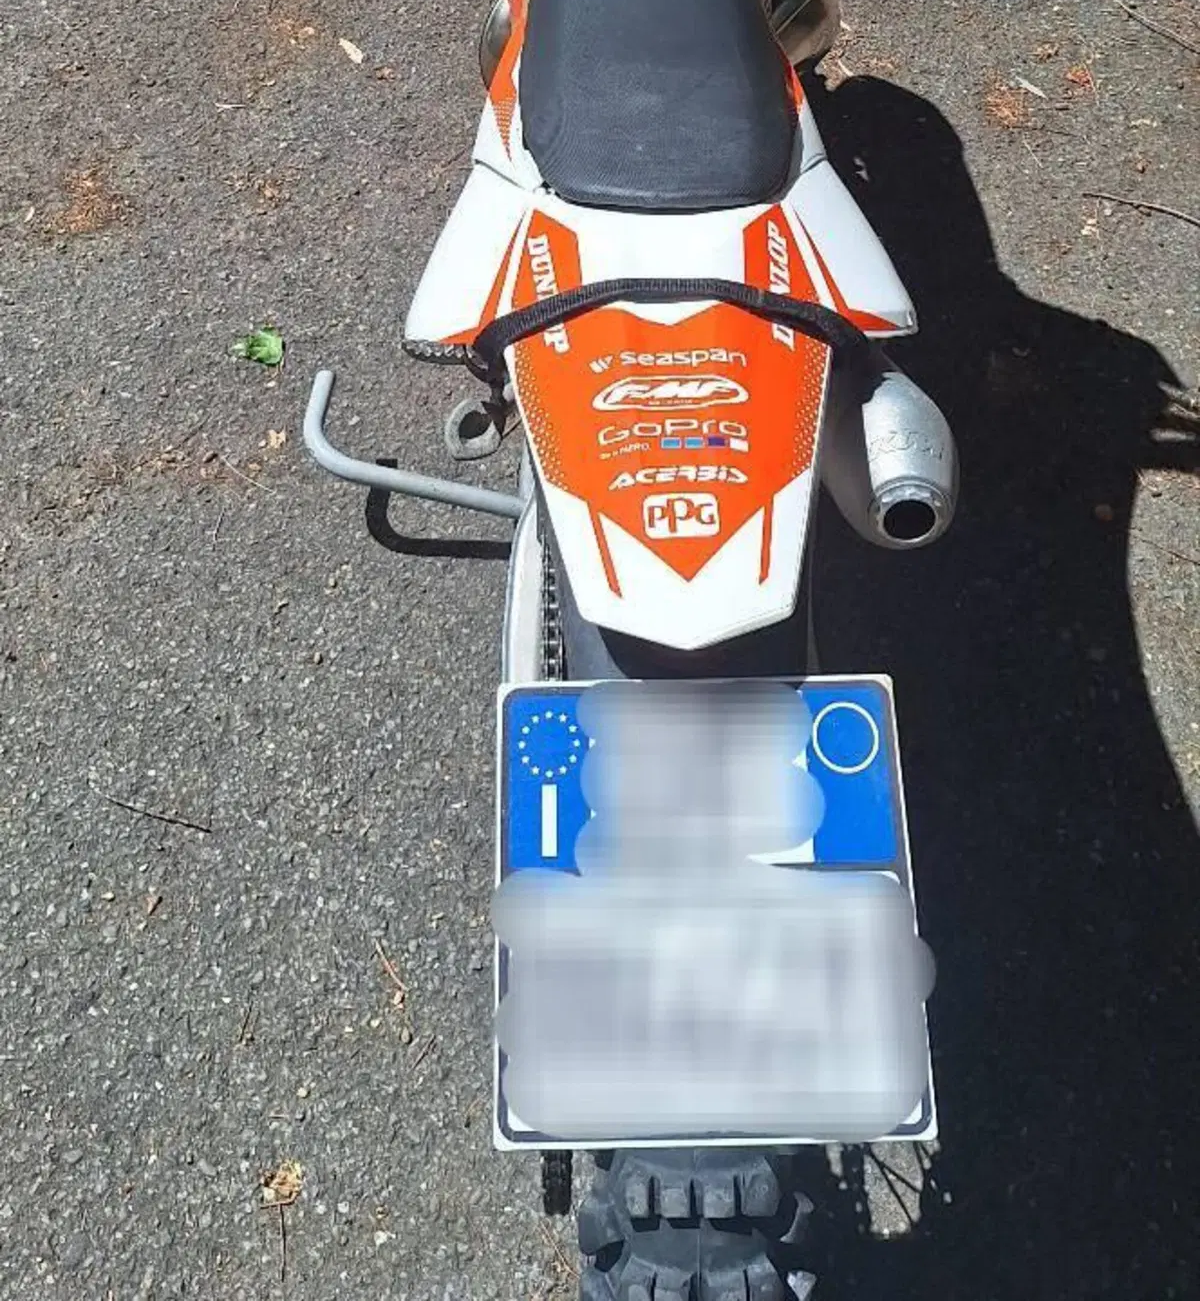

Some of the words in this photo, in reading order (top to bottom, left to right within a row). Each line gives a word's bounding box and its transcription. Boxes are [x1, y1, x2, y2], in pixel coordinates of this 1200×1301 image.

[527, 232, 570, 355] DUNP
[597, 418, 748, 446] GoPro
[608, 465, 749, 491] ACERBIS
[648, 498, 717, 533] PPG
